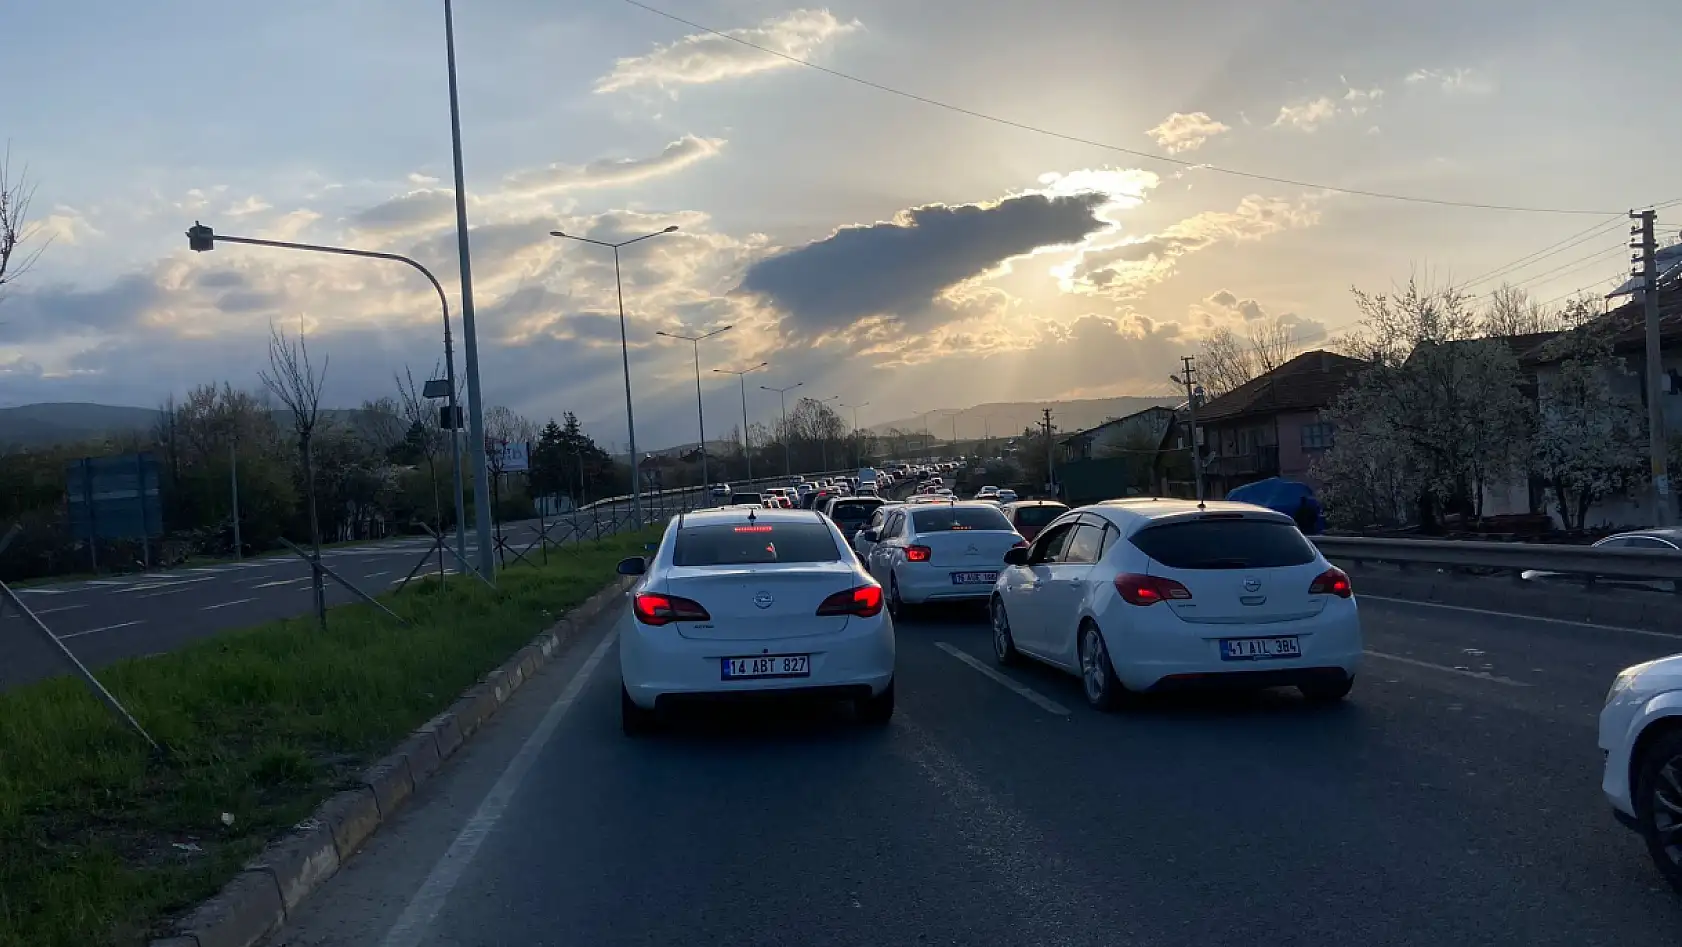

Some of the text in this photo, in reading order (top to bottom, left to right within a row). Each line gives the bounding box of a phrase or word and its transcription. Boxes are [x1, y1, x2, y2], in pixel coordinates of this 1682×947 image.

[1228, 639, 1297, 655] 41 AIL 384
[731, 657, 806, 674] 14 ABT 827
